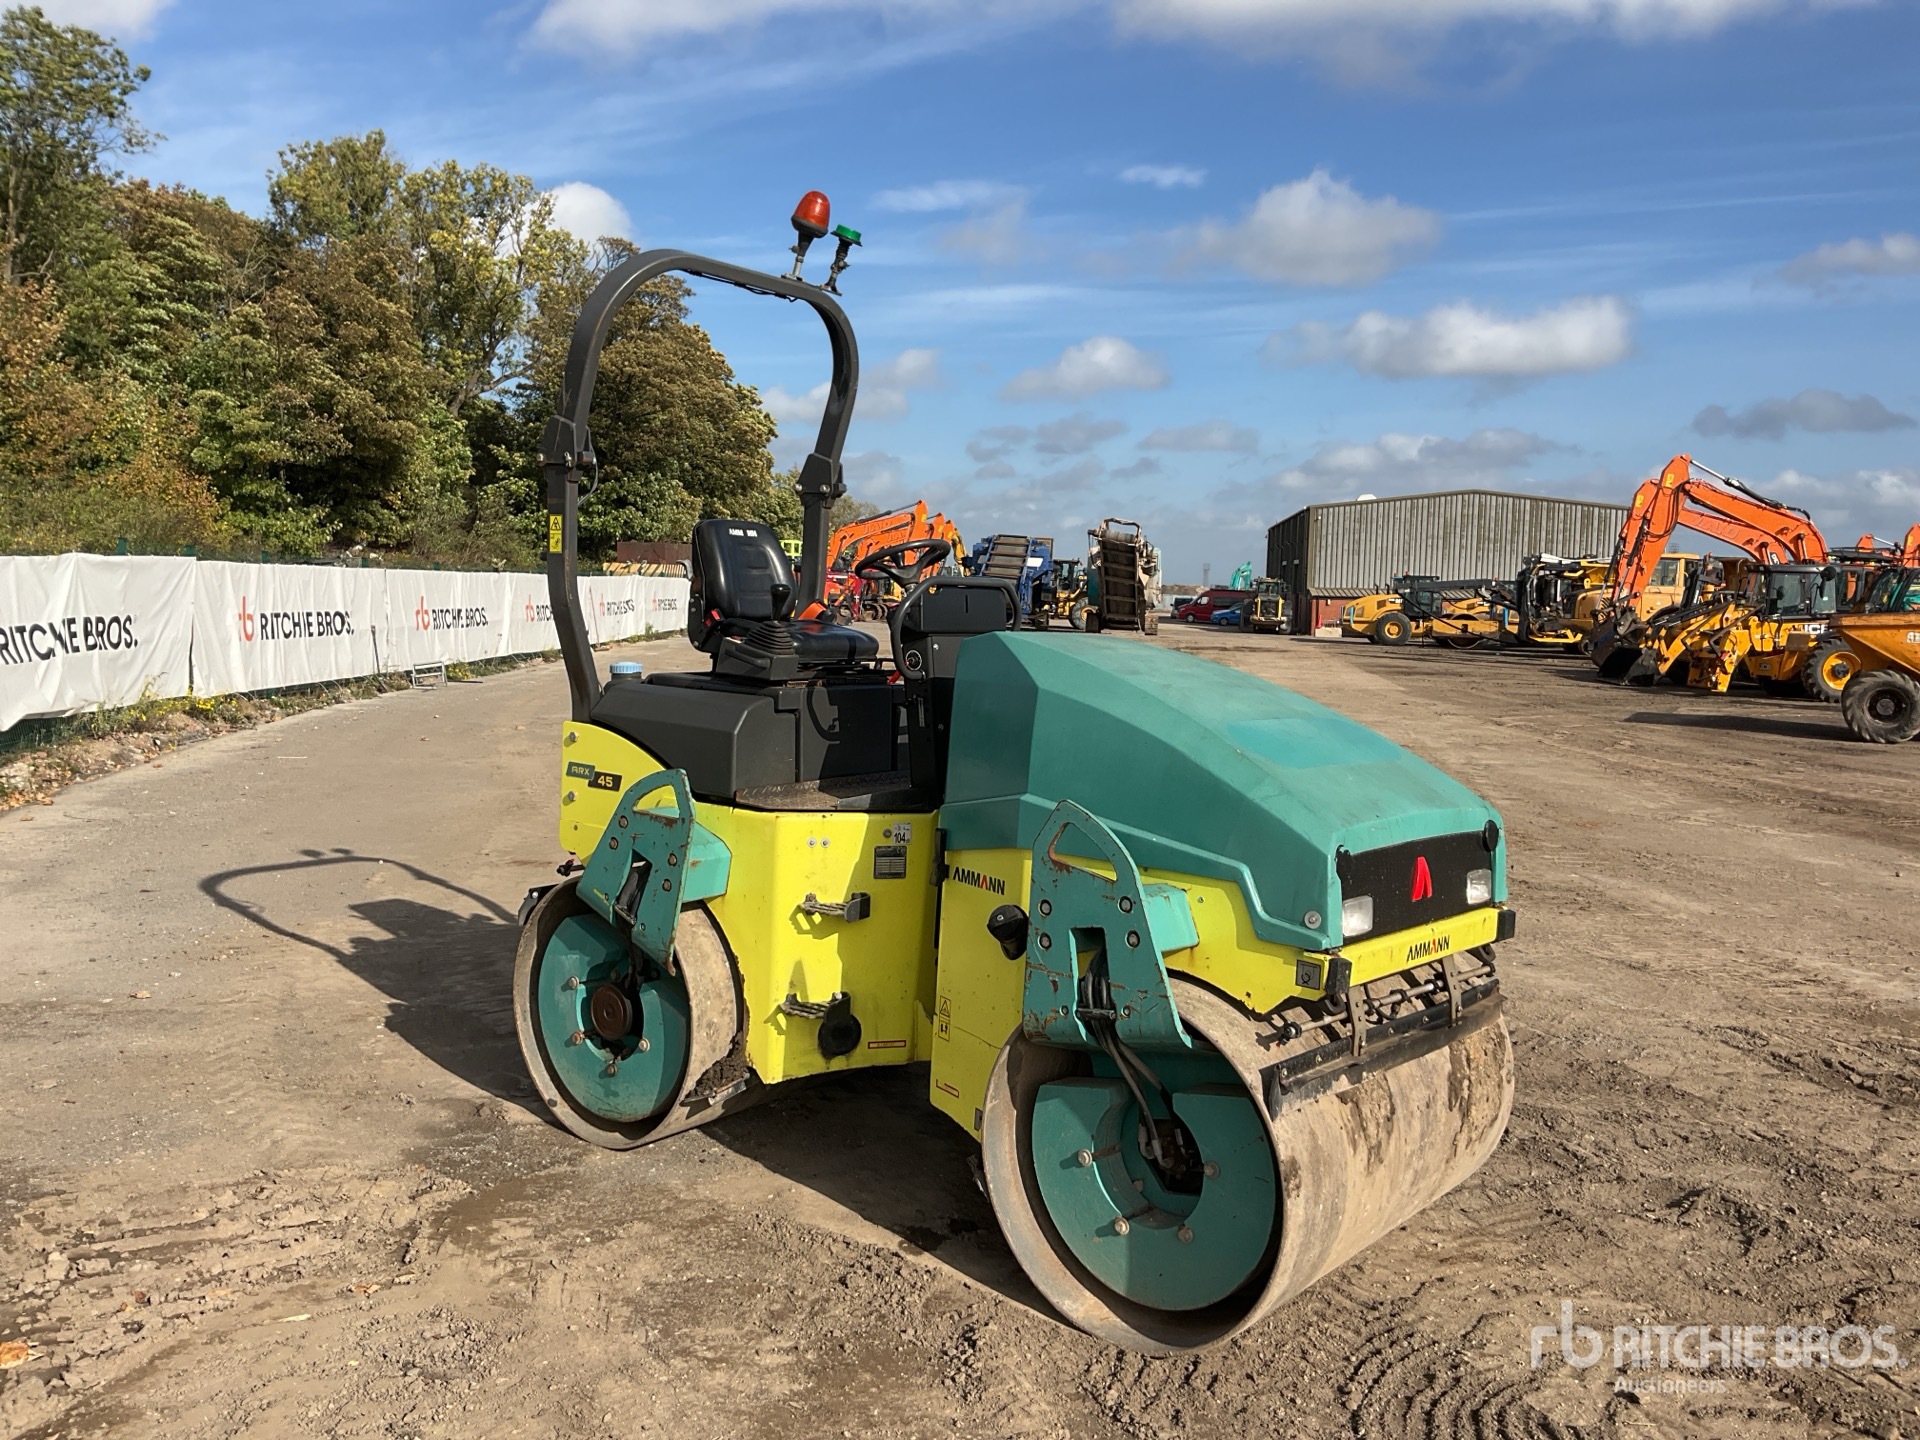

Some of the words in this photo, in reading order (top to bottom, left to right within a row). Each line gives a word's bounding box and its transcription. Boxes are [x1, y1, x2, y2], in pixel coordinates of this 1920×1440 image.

[82, 614, 139, 652] BROS.
[260, 611, 314, 640] RITCHIE
[316, 610, 355, 638] BROS.
[571, 765, 590, 776] ARX
[597, 774, 614, 788] 45
[893, 831, 906, 844] 104
[952, 866, 1005, 896] AMMANN
[1406, 935, 1450, 963] AMMANN
